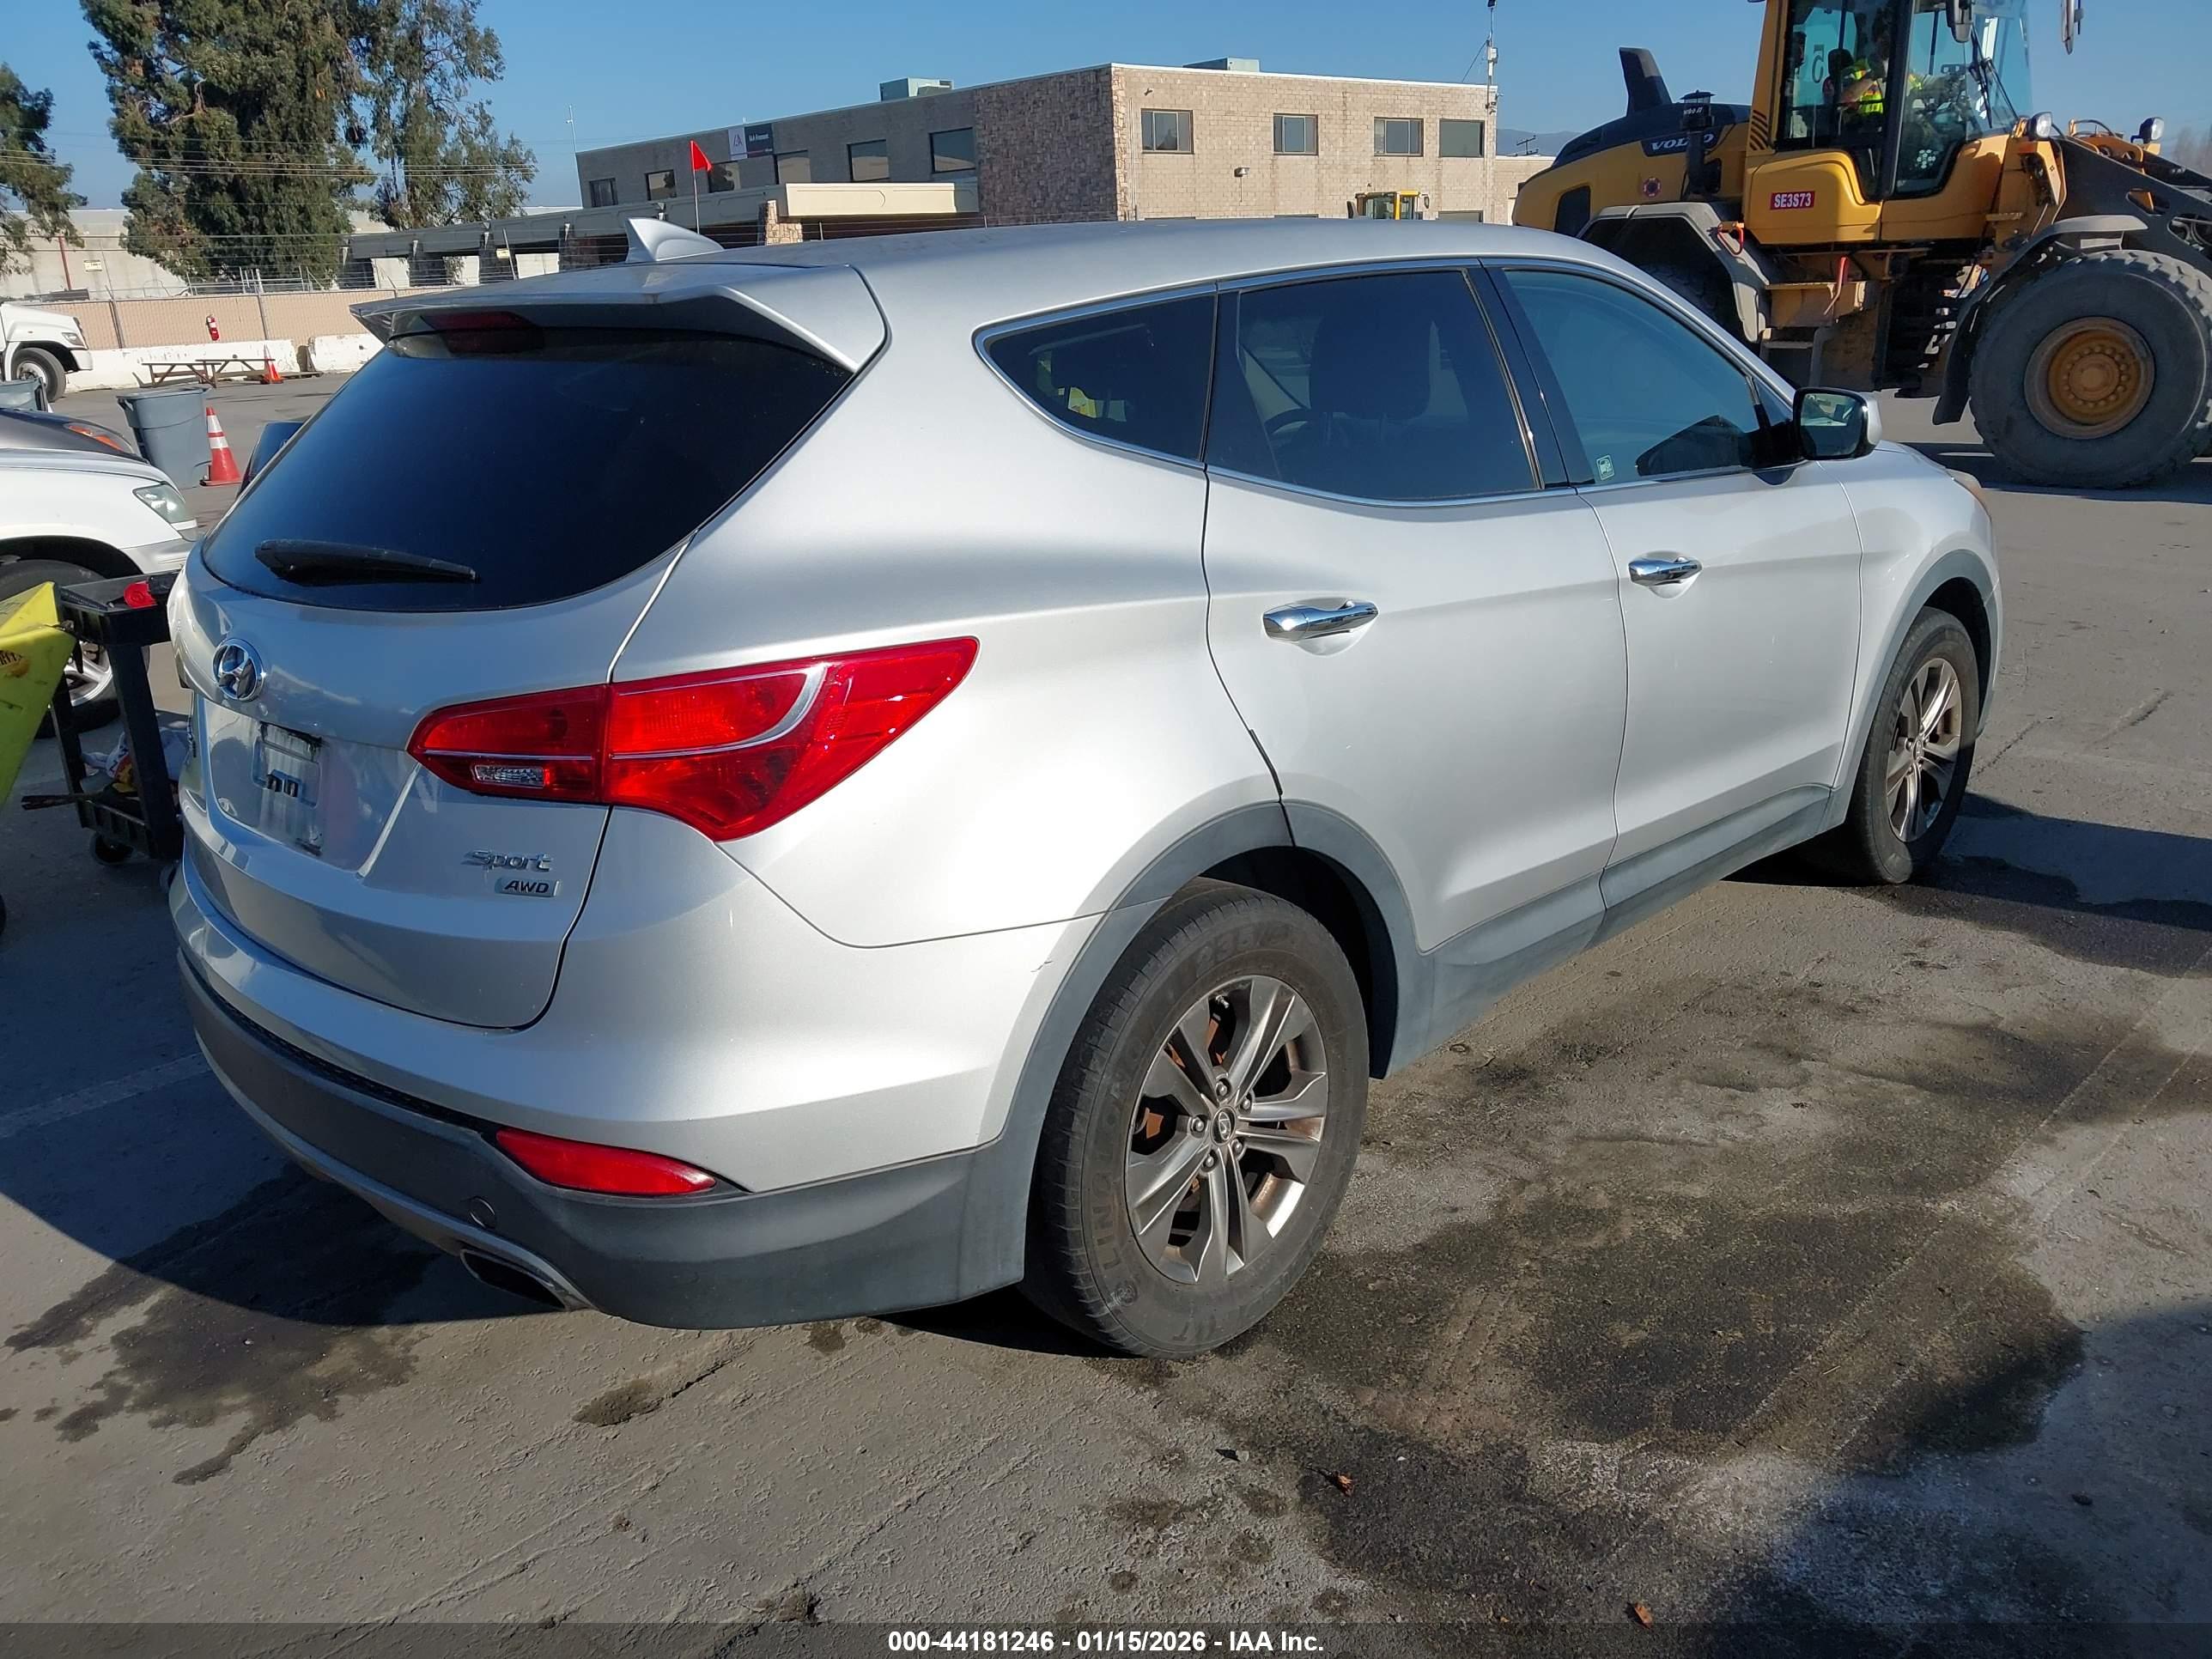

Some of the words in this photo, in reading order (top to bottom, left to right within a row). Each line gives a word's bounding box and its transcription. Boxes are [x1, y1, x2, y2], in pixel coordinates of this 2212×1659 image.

[1651, 133, 1715, 150] VOLO
[462, 848, 553, 873] Sport
[504, 880, 550, 894] AWD
